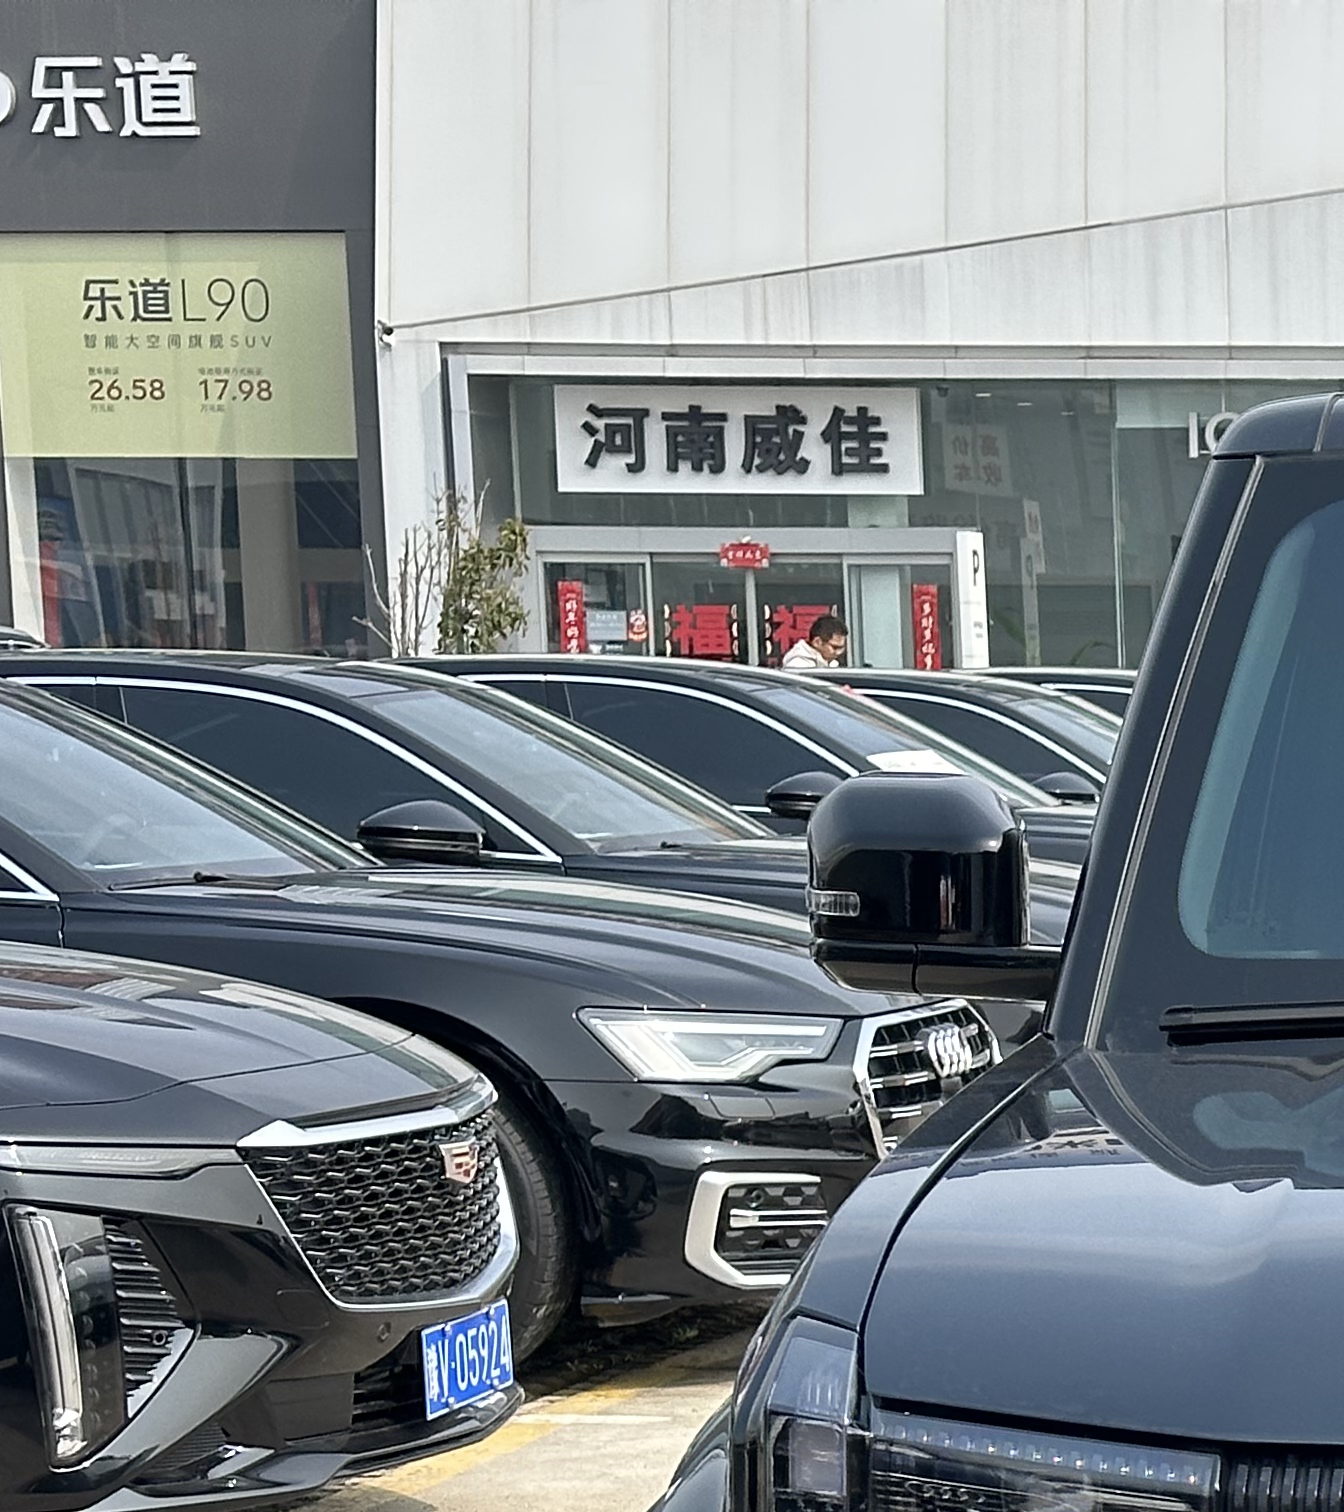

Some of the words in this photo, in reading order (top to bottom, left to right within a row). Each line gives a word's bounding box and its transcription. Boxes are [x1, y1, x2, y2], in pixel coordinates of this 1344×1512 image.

[31, 53, 200, 137] 乐道
[82, 277, 270, 323] 乐道L90
[88, 378, 166, 402] 26.58
[199, 378, 273, 402] 17.98
[580, 403, 891, 476] 河南威佳
[672, 604, 730, 655] 福
